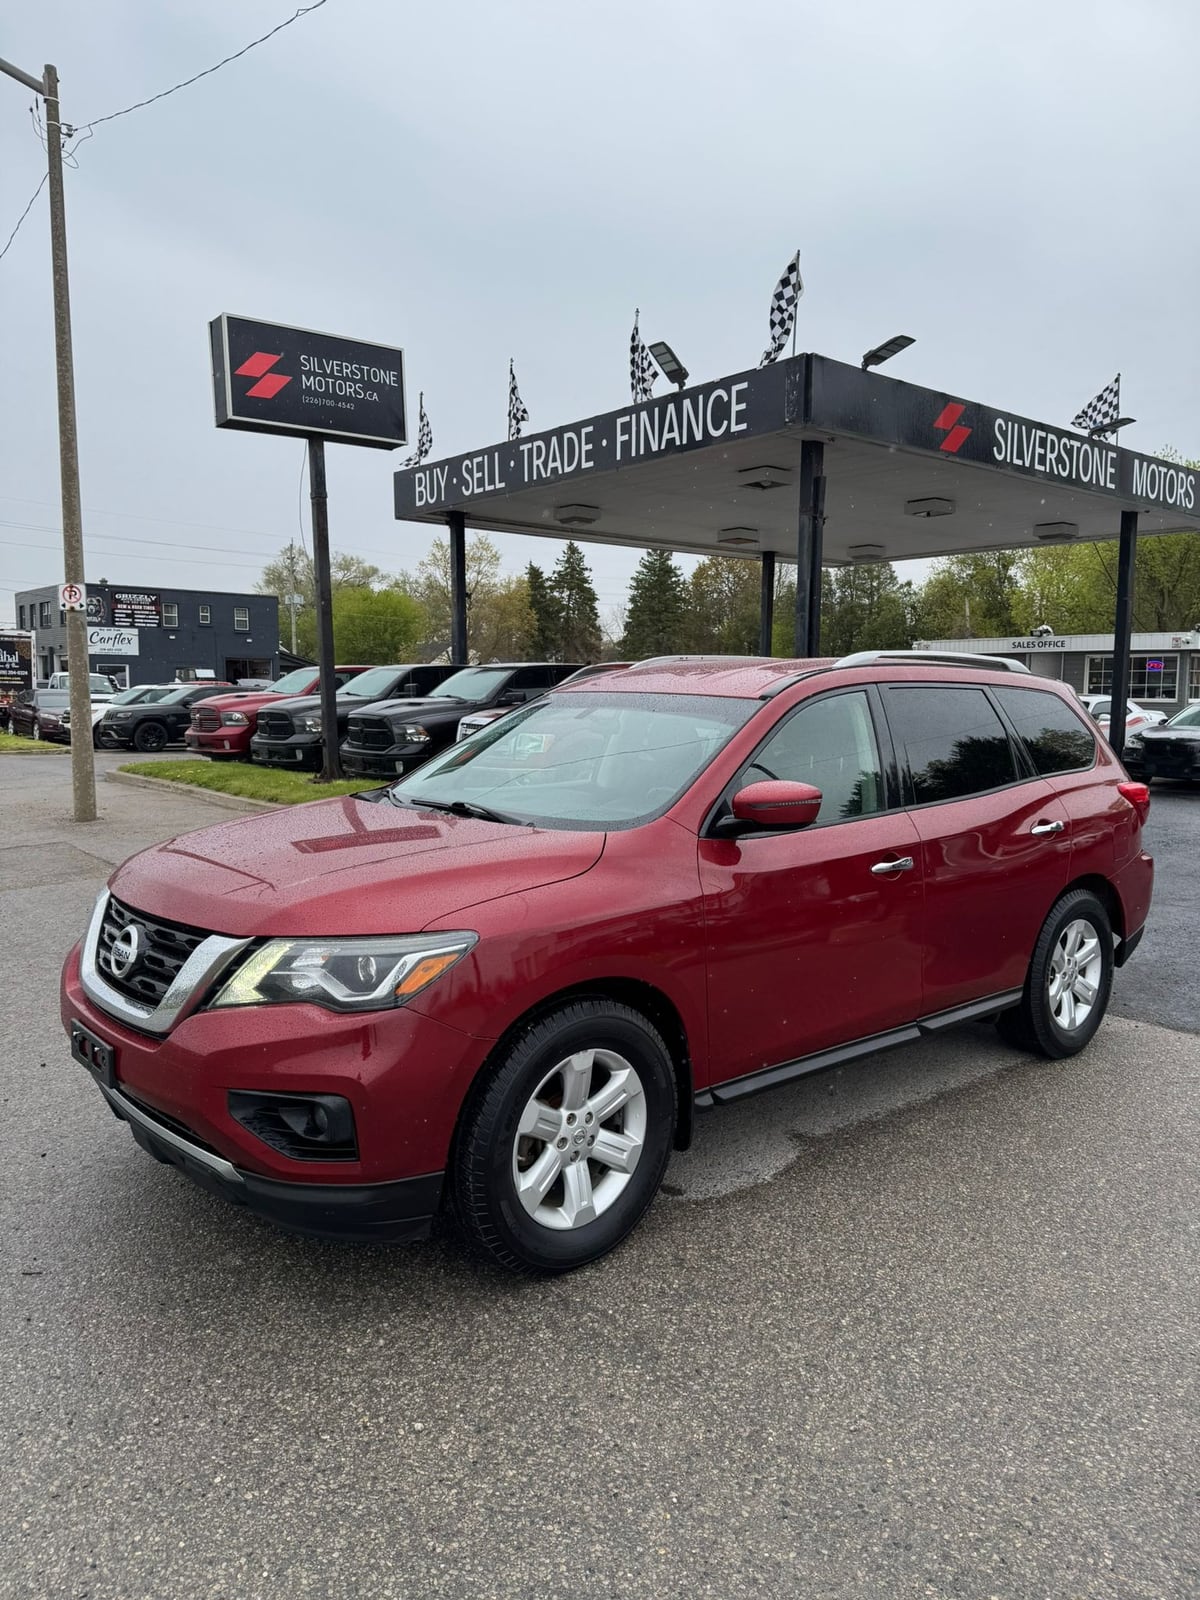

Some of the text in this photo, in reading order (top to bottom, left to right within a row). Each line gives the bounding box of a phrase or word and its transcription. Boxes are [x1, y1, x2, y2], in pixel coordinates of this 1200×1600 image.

[300, 354, 398, 387] SILVERSTONE
[302, 374, 379, 402] MOTORS.CA
[302, 395, 355, 410] (226)700-4542
[414, 381, 748, 507] BUY SELL TRADE FINANCE
[993, 418, 1195, 510] SILVERSTONE MOTORS
[115, 593, 157, 601] GRIZZLY
[90, 631, 133, 647] Carflex
[1012, 640, 1066, 649] SALES OFFICE
